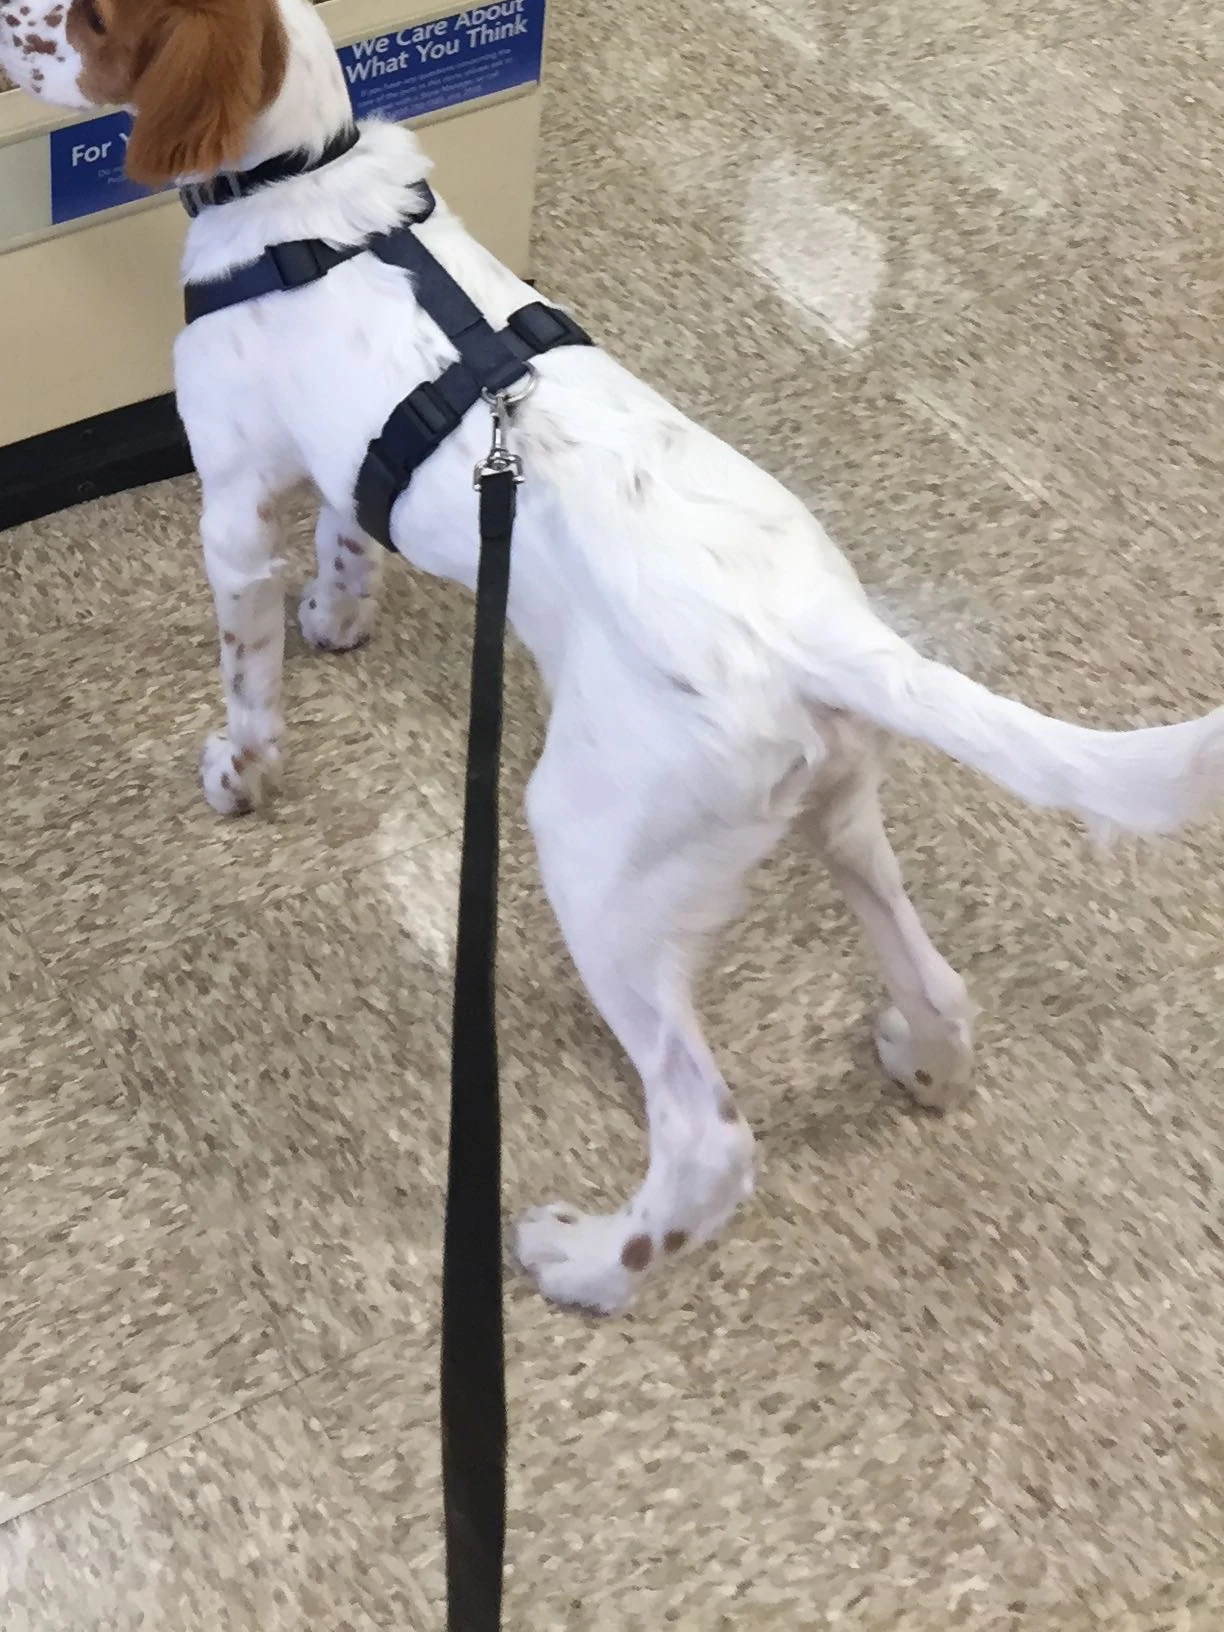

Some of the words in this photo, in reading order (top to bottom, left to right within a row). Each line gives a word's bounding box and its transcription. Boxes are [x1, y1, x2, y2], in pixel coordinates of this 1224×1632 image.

[346, 52, 409, 84] What
[416, 39, 460, 63] You
[466, 14, 528, 49] Think
[352, 40, 389, 60] We
[396, 20, 447, 46] Care
[72, 141, 112, 167] For
